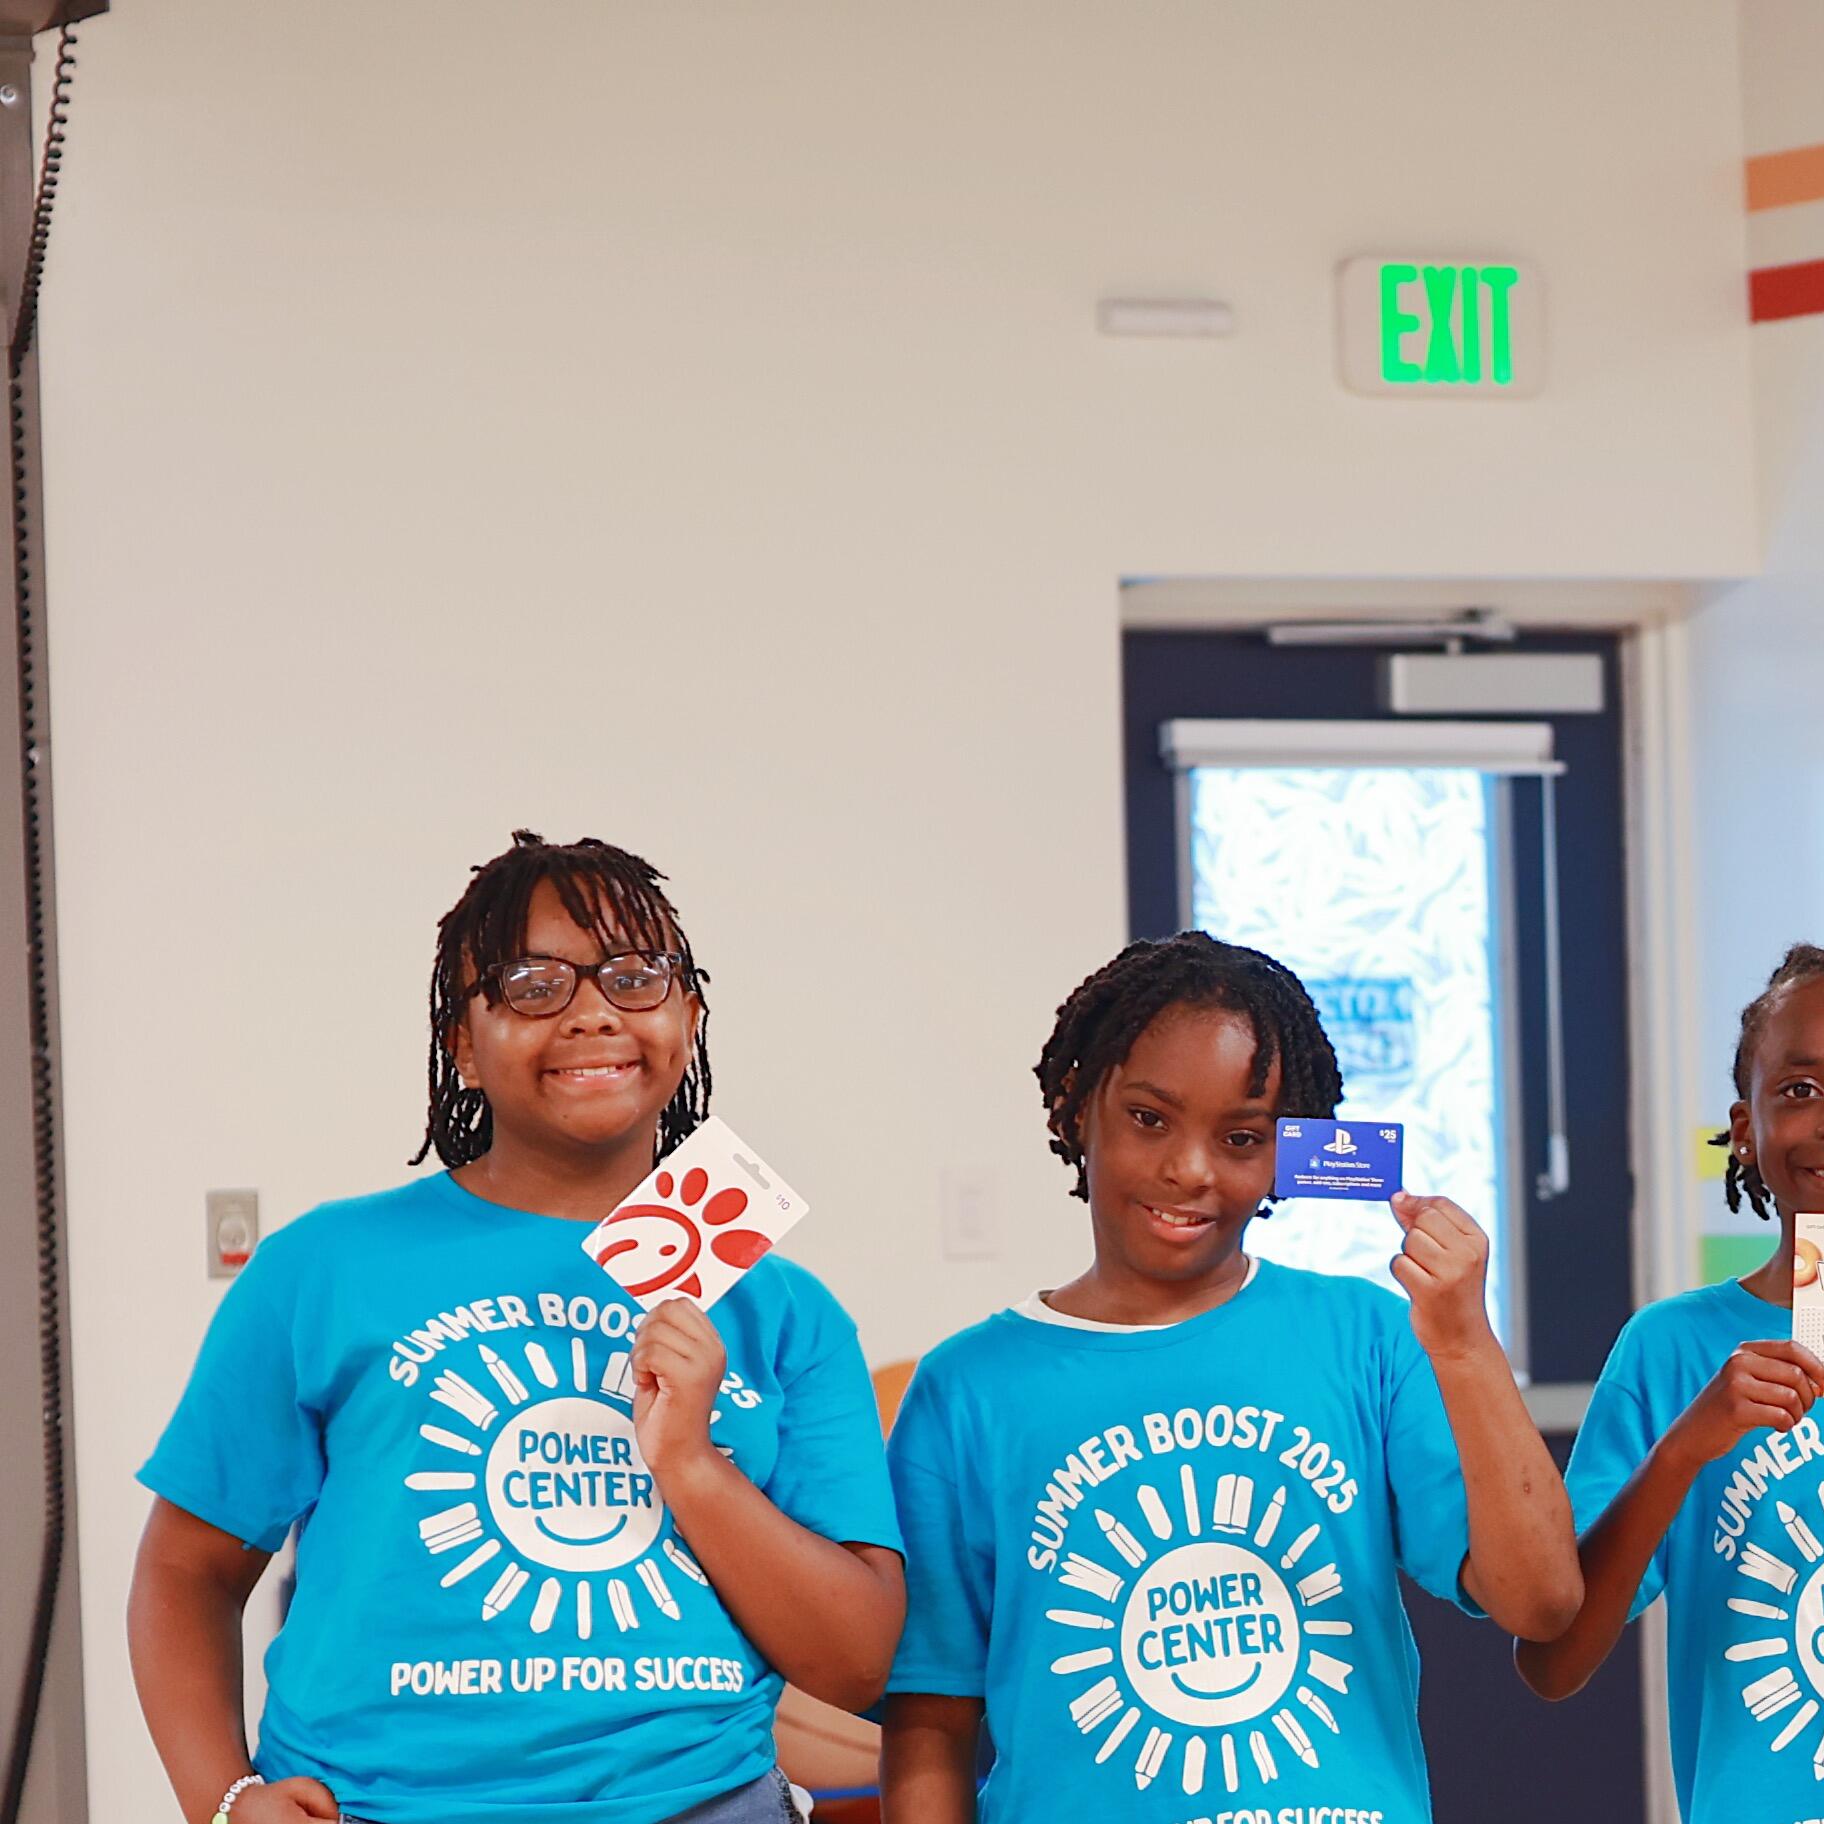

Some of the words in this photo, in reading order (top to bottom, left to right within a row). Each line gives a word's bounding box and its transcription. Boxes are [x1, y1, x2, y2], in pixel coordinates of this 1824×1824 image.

[1379, 264, 1519, 385] EXIT
[1379, 1129, 1397, 1140] $25
[389, 1295, 533, 1387] SUMMER
[519, 1430, 632, 1466] POWER
[503, 1470, 653, 1510] CENTER
[1028, 1425, 1142, 1574] SUMMER
[1143, 1405, 1284, 1455] BOOST
[1279, 1427, 1358, 1514] 2025
[1147, 1573, 1264, 1622] POWER
[1137, 1614, 1284, 1670] CENTER
[391, 1659, 501, 1695] POWER
[511, 1657, 556, 1692] UP
[562, 1657, 626, 1692] FOR
[634, 1656, 744, 1692] SUCCESS
